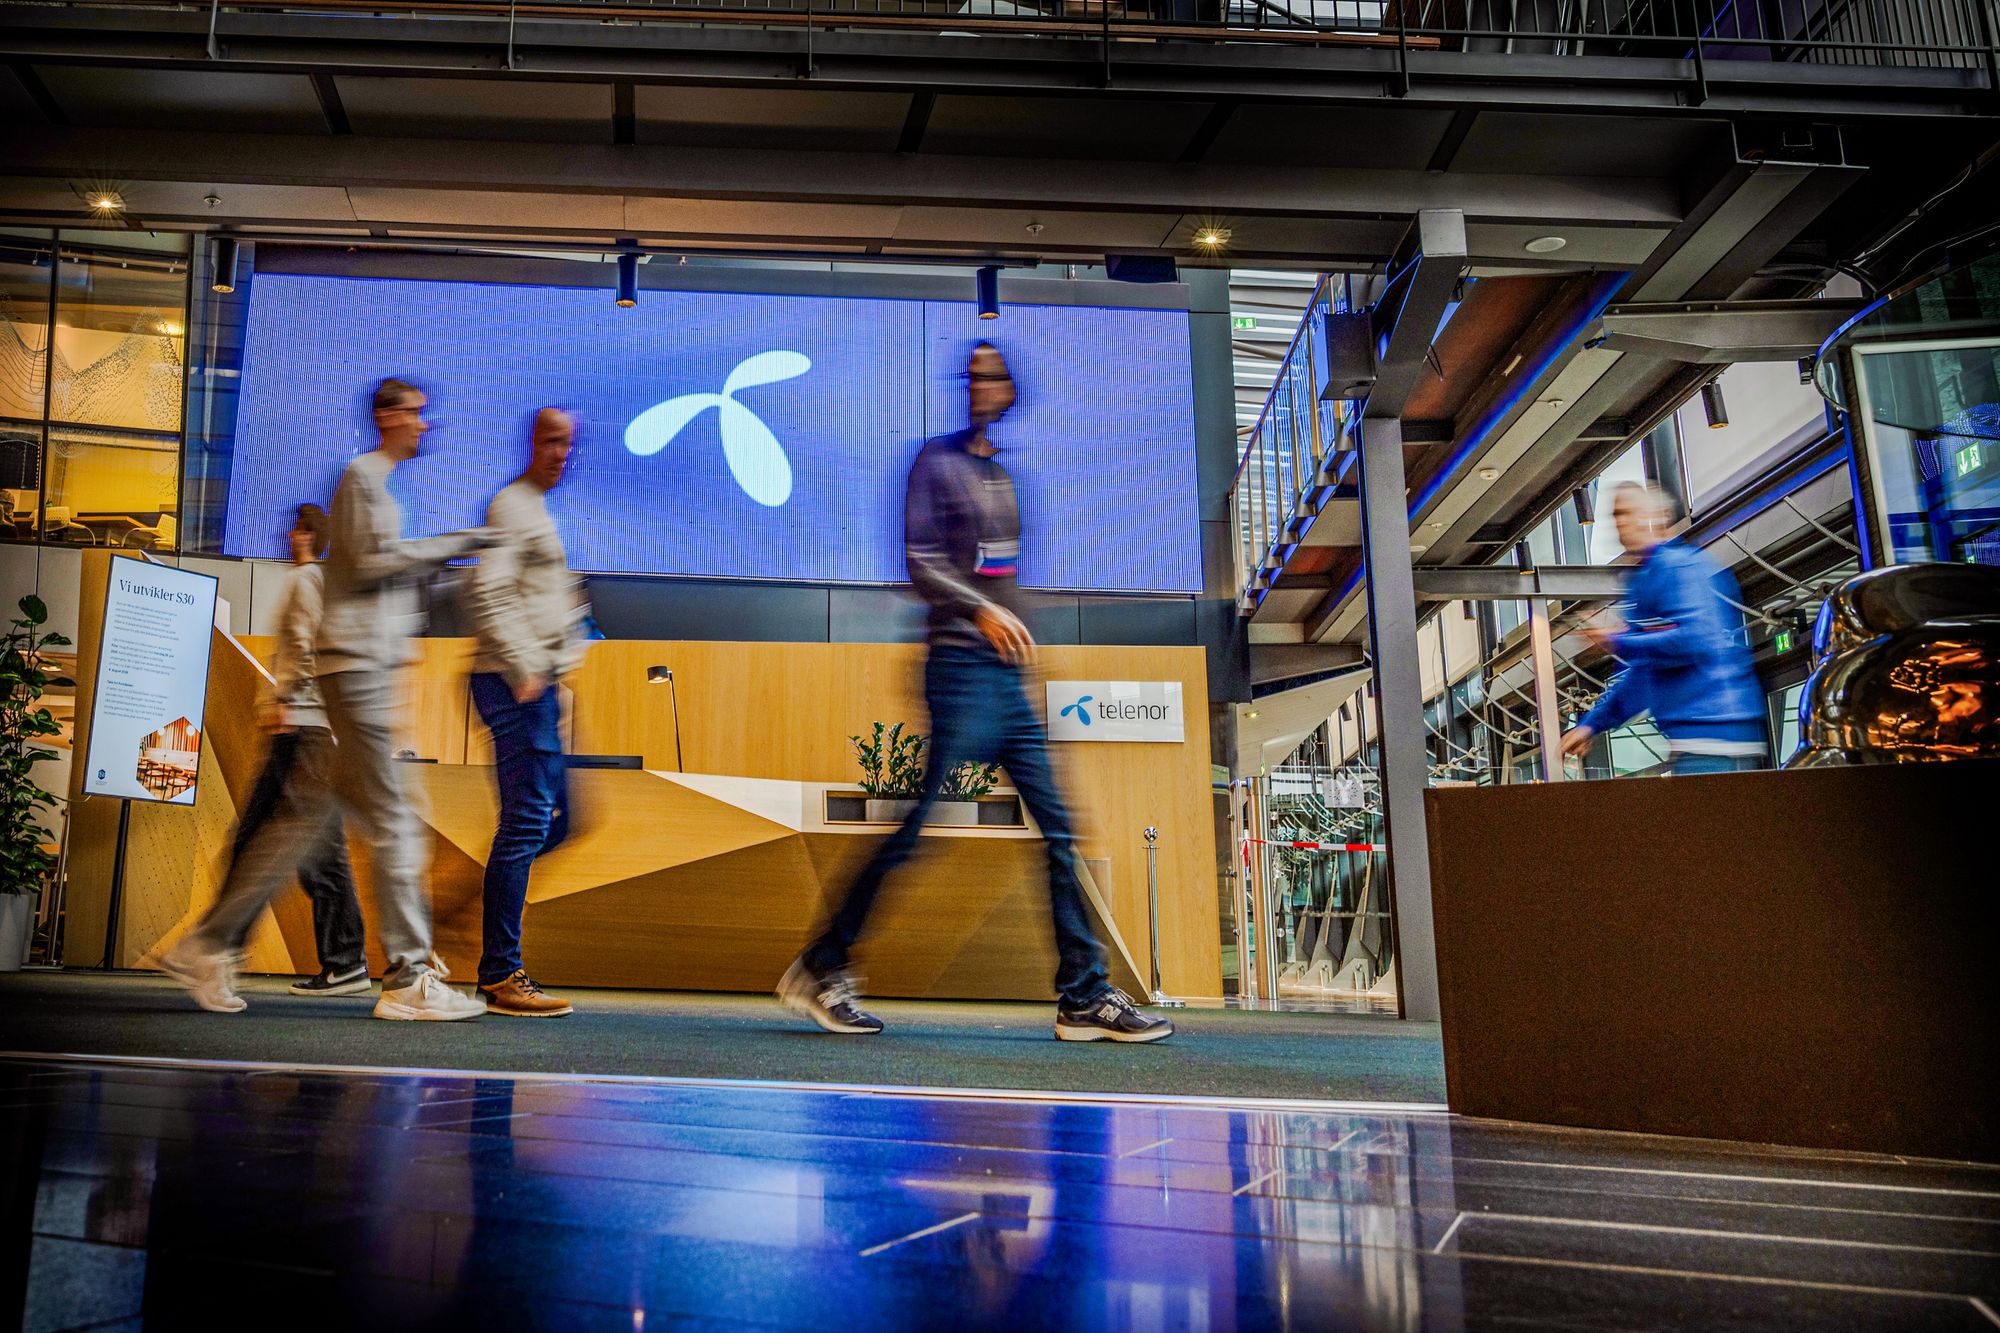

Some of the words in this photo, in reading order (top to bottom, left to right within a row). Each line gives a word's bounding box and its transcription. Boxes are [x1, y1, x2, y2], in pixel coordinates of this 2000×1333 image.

[119, 579, 131, 593] Vi
[133, 584, 174, 601] utvikler
[175, 592, 195, 606] S30
[1098, 700, 1169, 720] telenor
